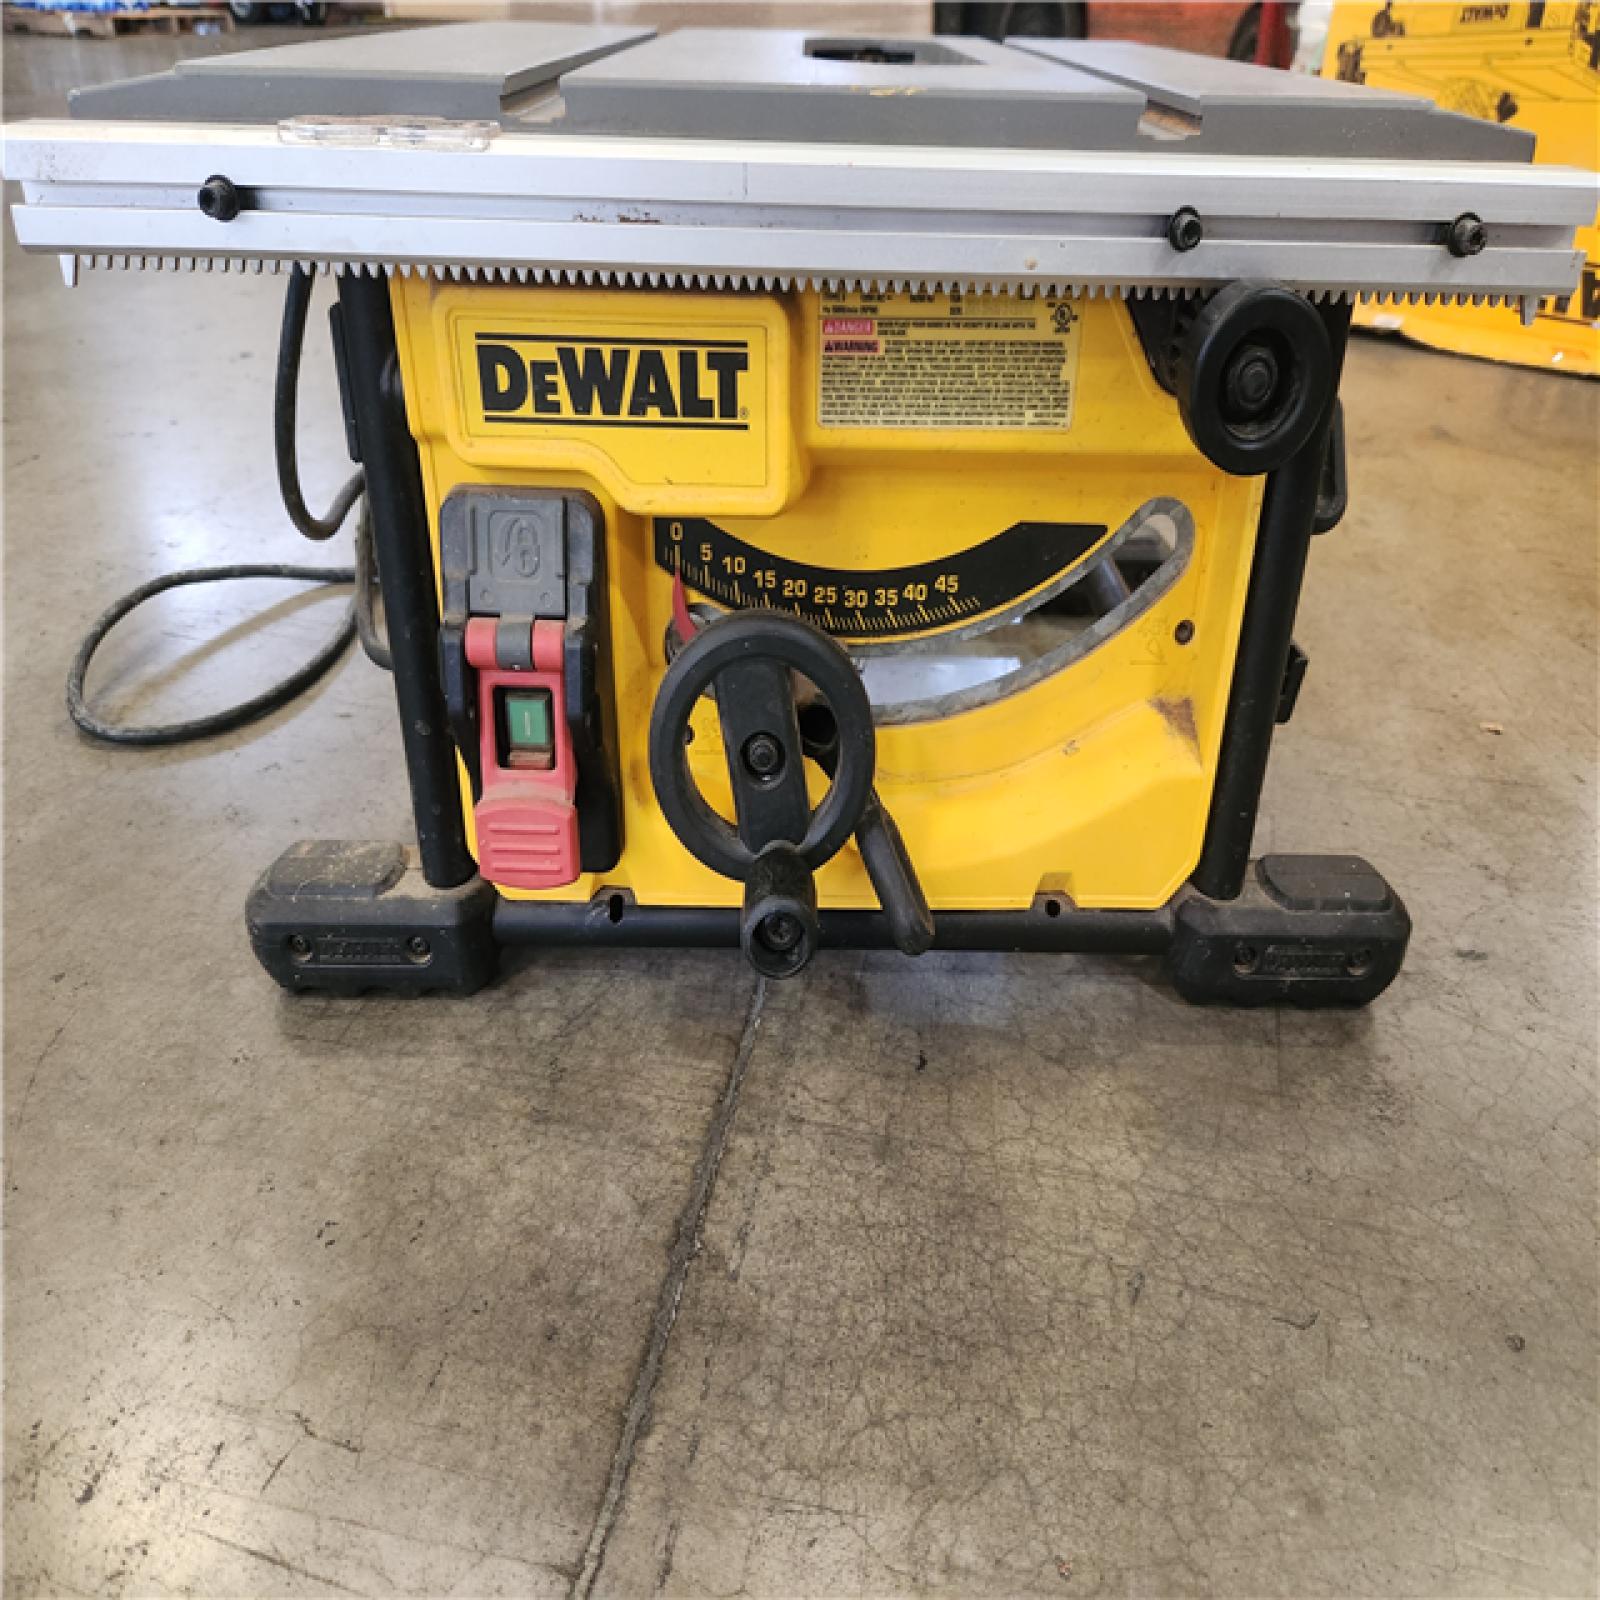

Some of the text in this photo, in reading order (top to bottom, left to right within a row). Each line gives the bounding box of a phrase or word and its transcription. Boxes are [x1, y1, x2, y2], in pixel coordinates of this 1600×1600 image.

[834, 340, 878, 353] WARNING
[835, 319, 872, 334] DANGER
[476, 344, 748, 418] DEWALT
[669, 521, 959, 609] 0 5 10 15 20 25 30 35 40 45
